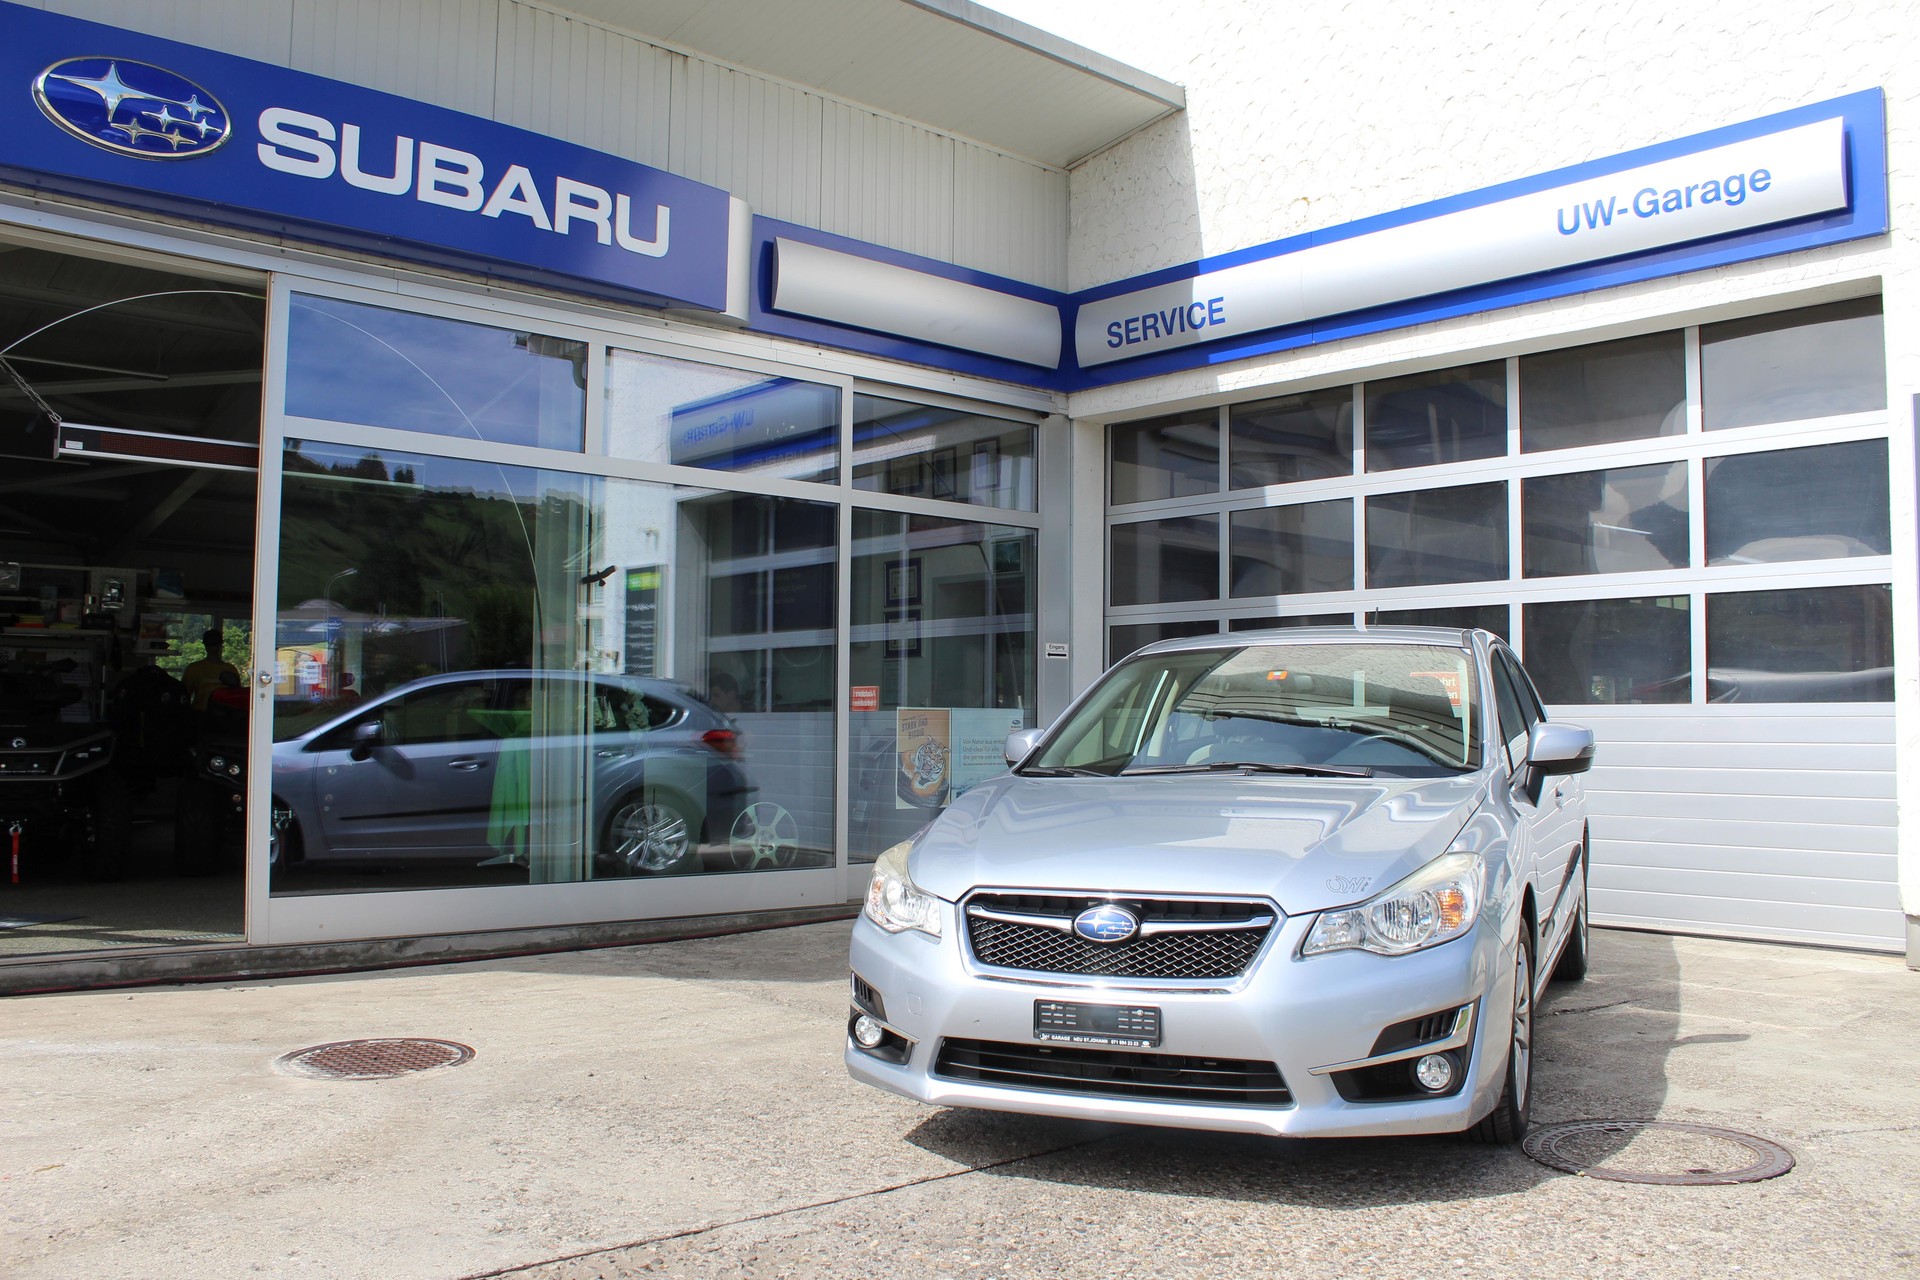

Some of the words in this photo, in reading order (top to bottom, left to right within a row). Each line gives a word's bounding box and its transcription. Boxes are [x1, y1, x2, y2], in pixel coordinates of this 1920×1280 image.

[257, 107, 670, 258] SUBARU
[1557, 168, 1771, 236] UW-Garage
[1106, 296, 1226, 349] SERVICE
[1048, 643, 1066, 651] Eingang
